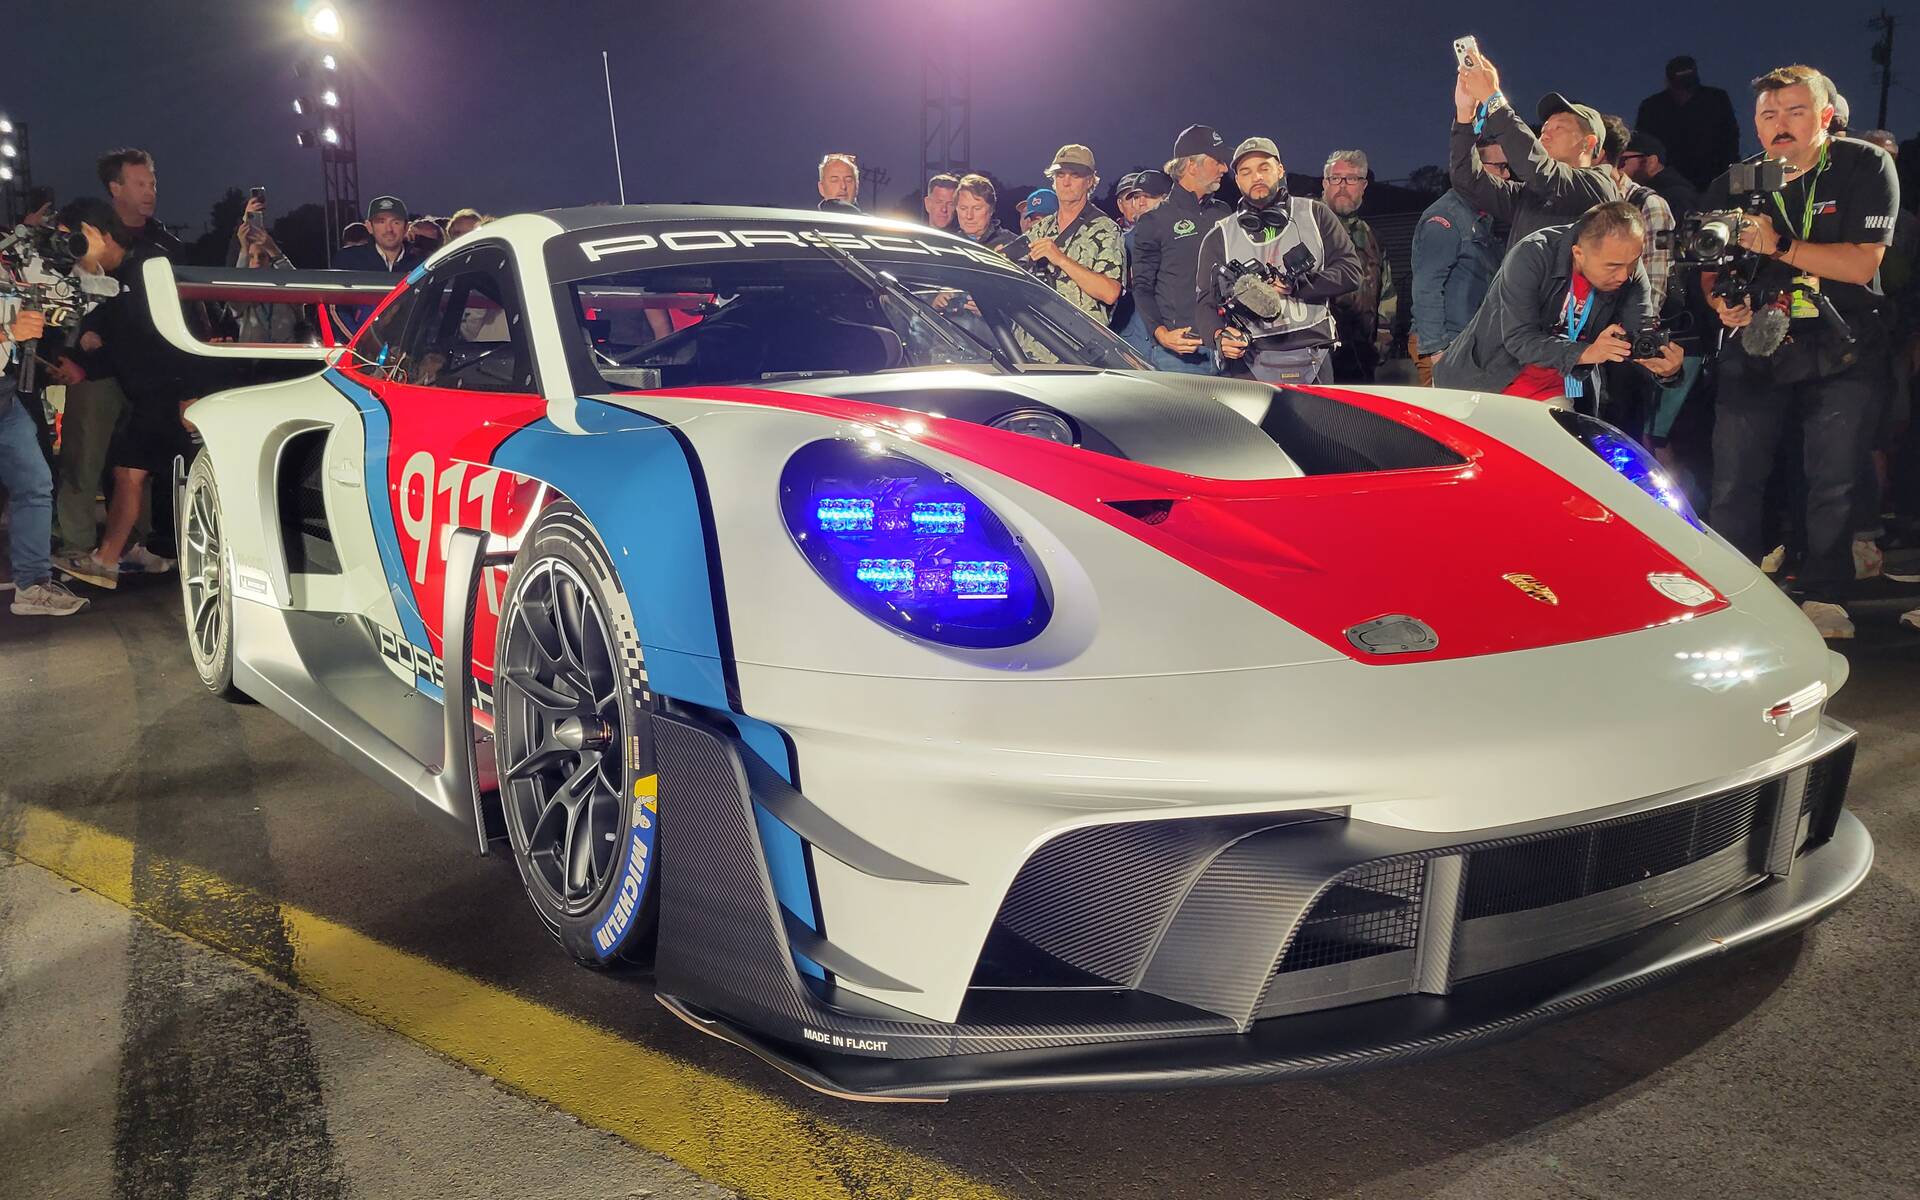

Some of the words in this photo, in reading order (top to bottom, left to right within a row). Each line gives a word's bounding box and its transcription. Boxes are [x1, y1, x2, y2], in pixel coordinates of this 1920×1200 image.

[579, 230, 1026, 276] PORSCHE
[400, 451, 500, 617] 911
[597, 834, 648, 951] MICHELIN
[803, 1028, 831, 1044] MADE
[832, 1035, 844, 1047] IN
[846, 1038, 889, 1052] FLACHT
